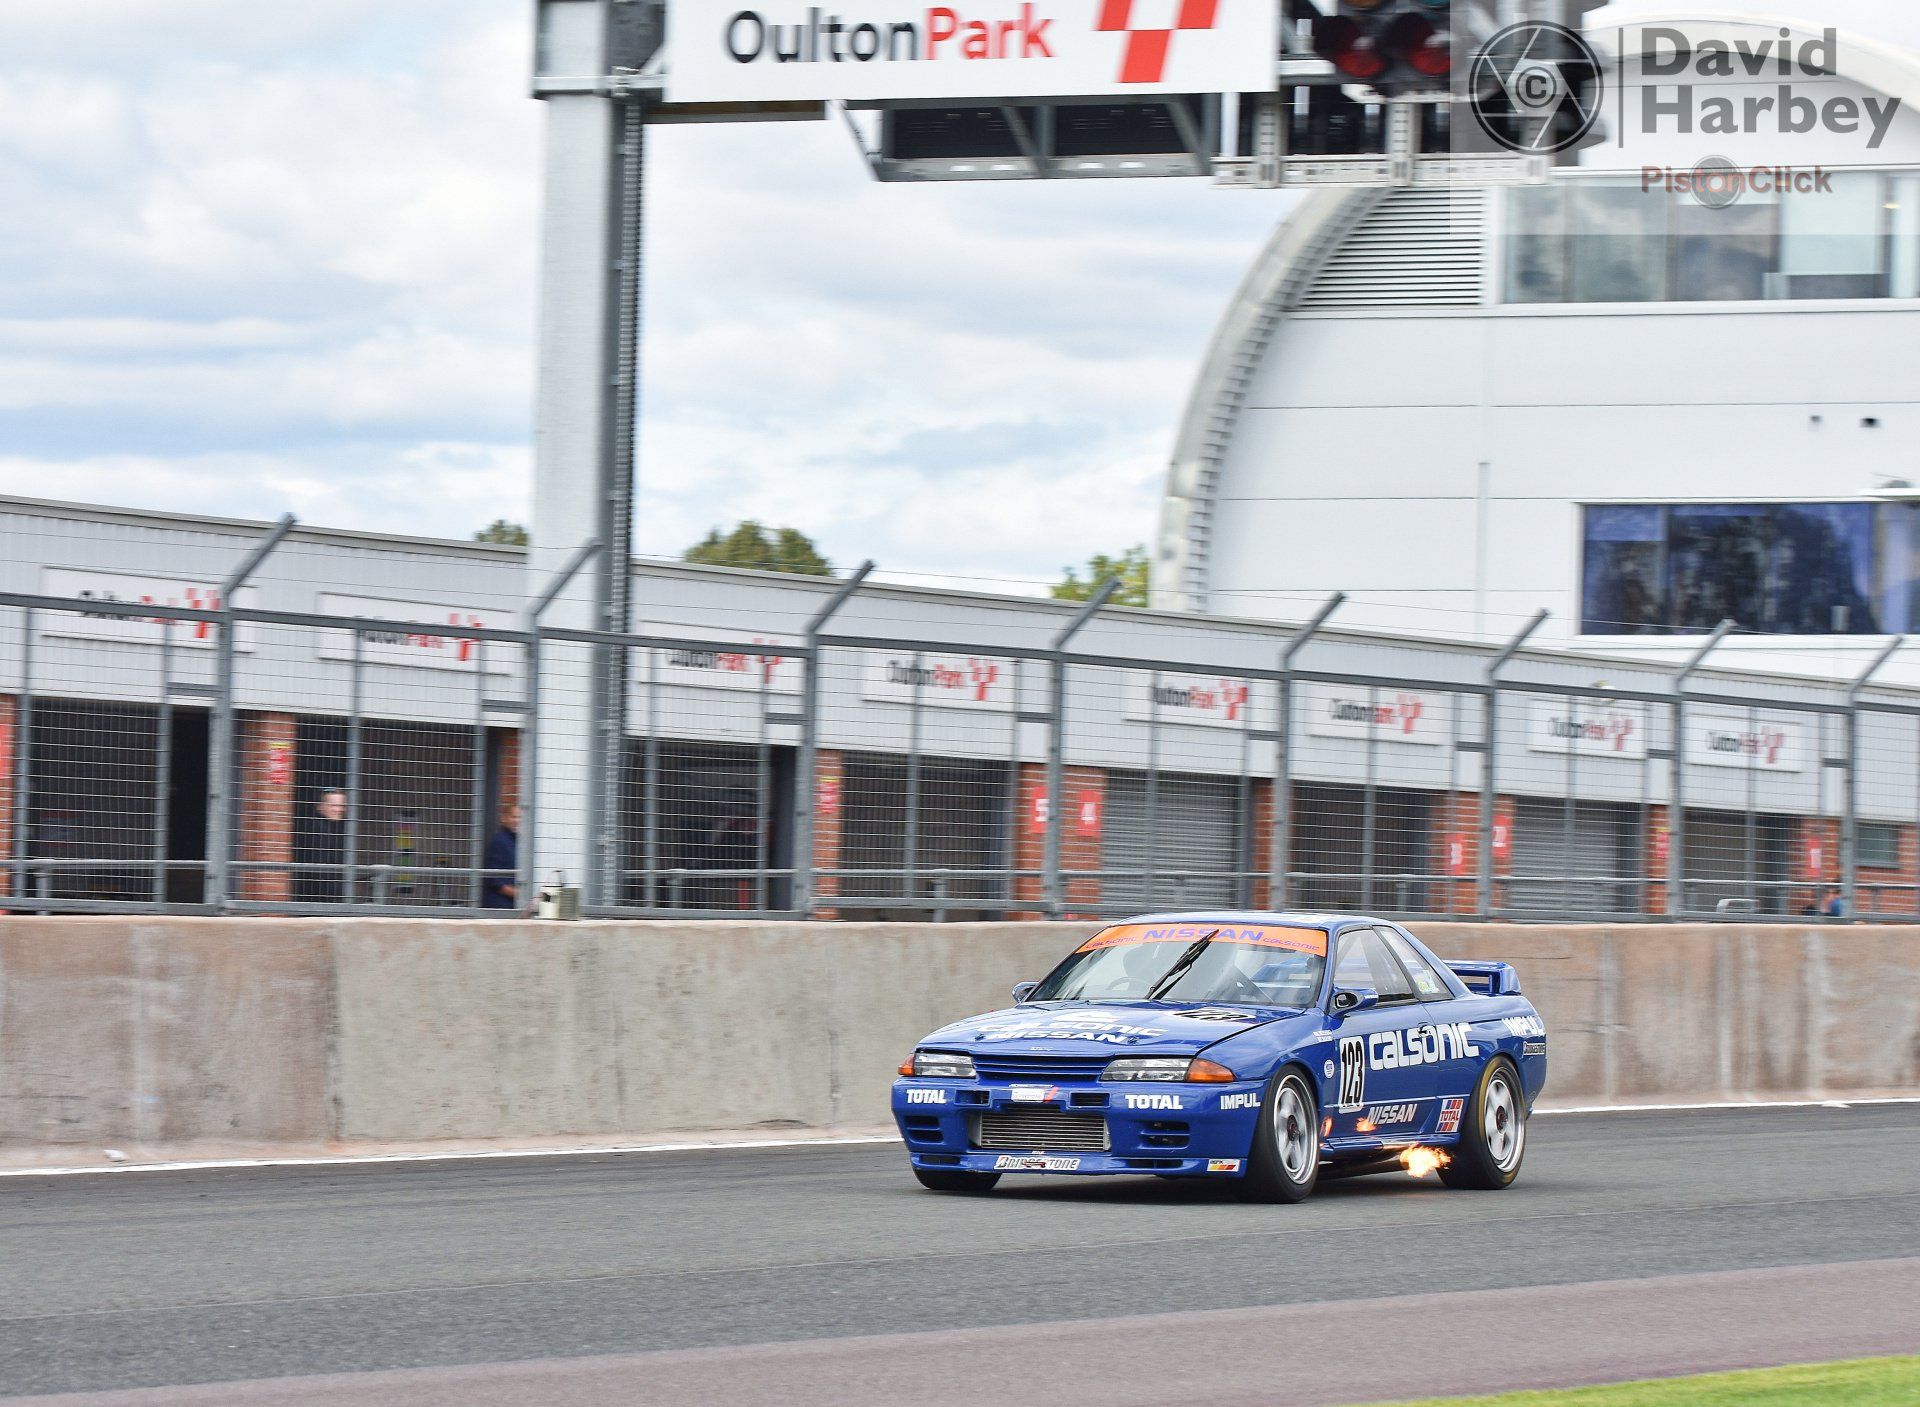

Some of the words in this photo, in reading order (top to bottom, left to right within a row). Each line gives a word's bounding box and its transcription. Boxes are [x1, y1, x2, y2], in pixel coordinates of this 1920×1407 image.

[723, 3, 1055, 63] OultonPark
[1081, 802, 1097, 825] 4
[1143, 928, 1265, 941] NISSAN
[985, 1031, 1128, 1043] NISSAN
[1341, 1040, 1363, 1107] 123
[906, 1089, 947, 1104] TOTAL
[1125, 1094, 1183, 1110] TOTAL
[1220, 1093, 1261, 1110] IMPUL
[1367, 1103, 1417, 1125] NISSAN
[1440, 1109, 1460, 1122] TOTAL
